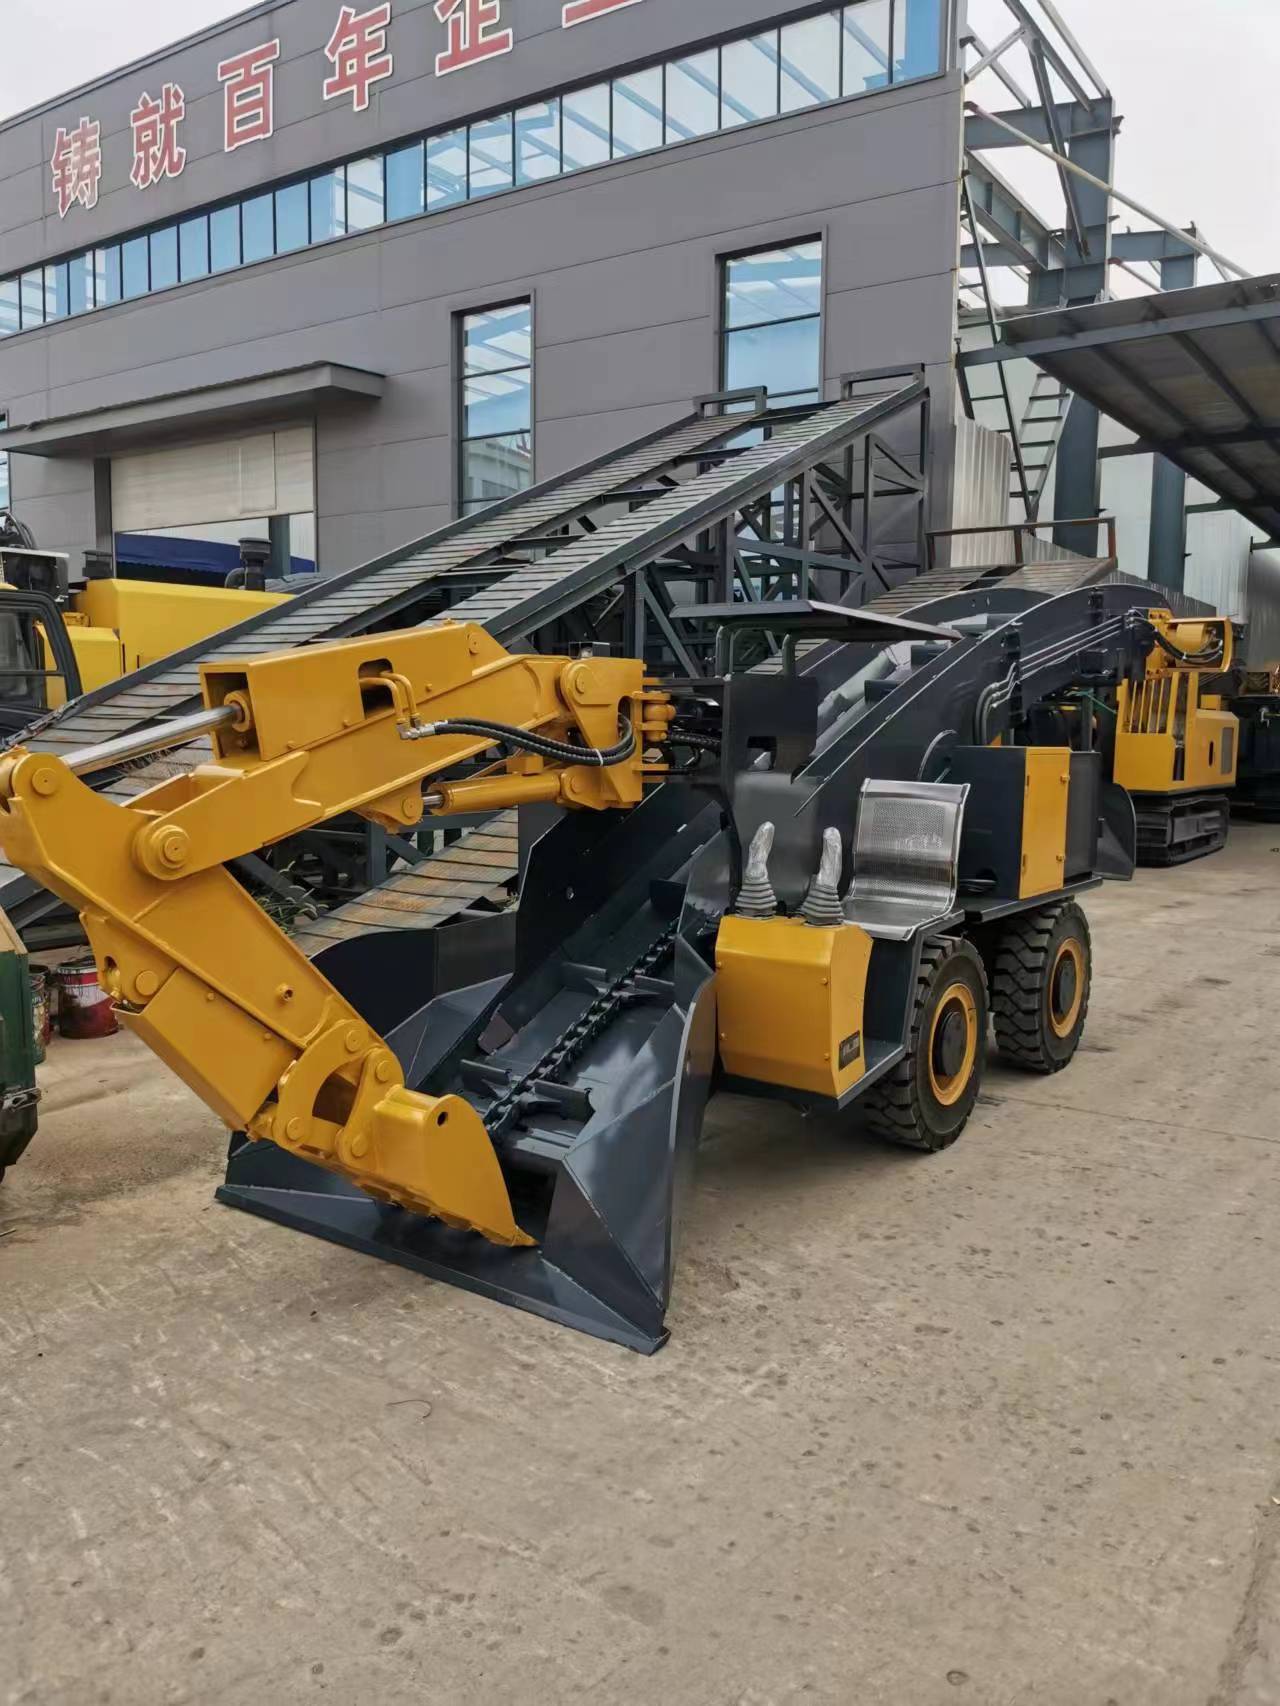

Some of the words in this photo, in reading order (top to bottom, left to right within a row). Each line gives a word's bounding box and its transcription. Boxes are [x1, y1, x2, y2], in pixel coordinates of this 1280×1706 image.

[51, 0, 643, 219] 铸就百年企
